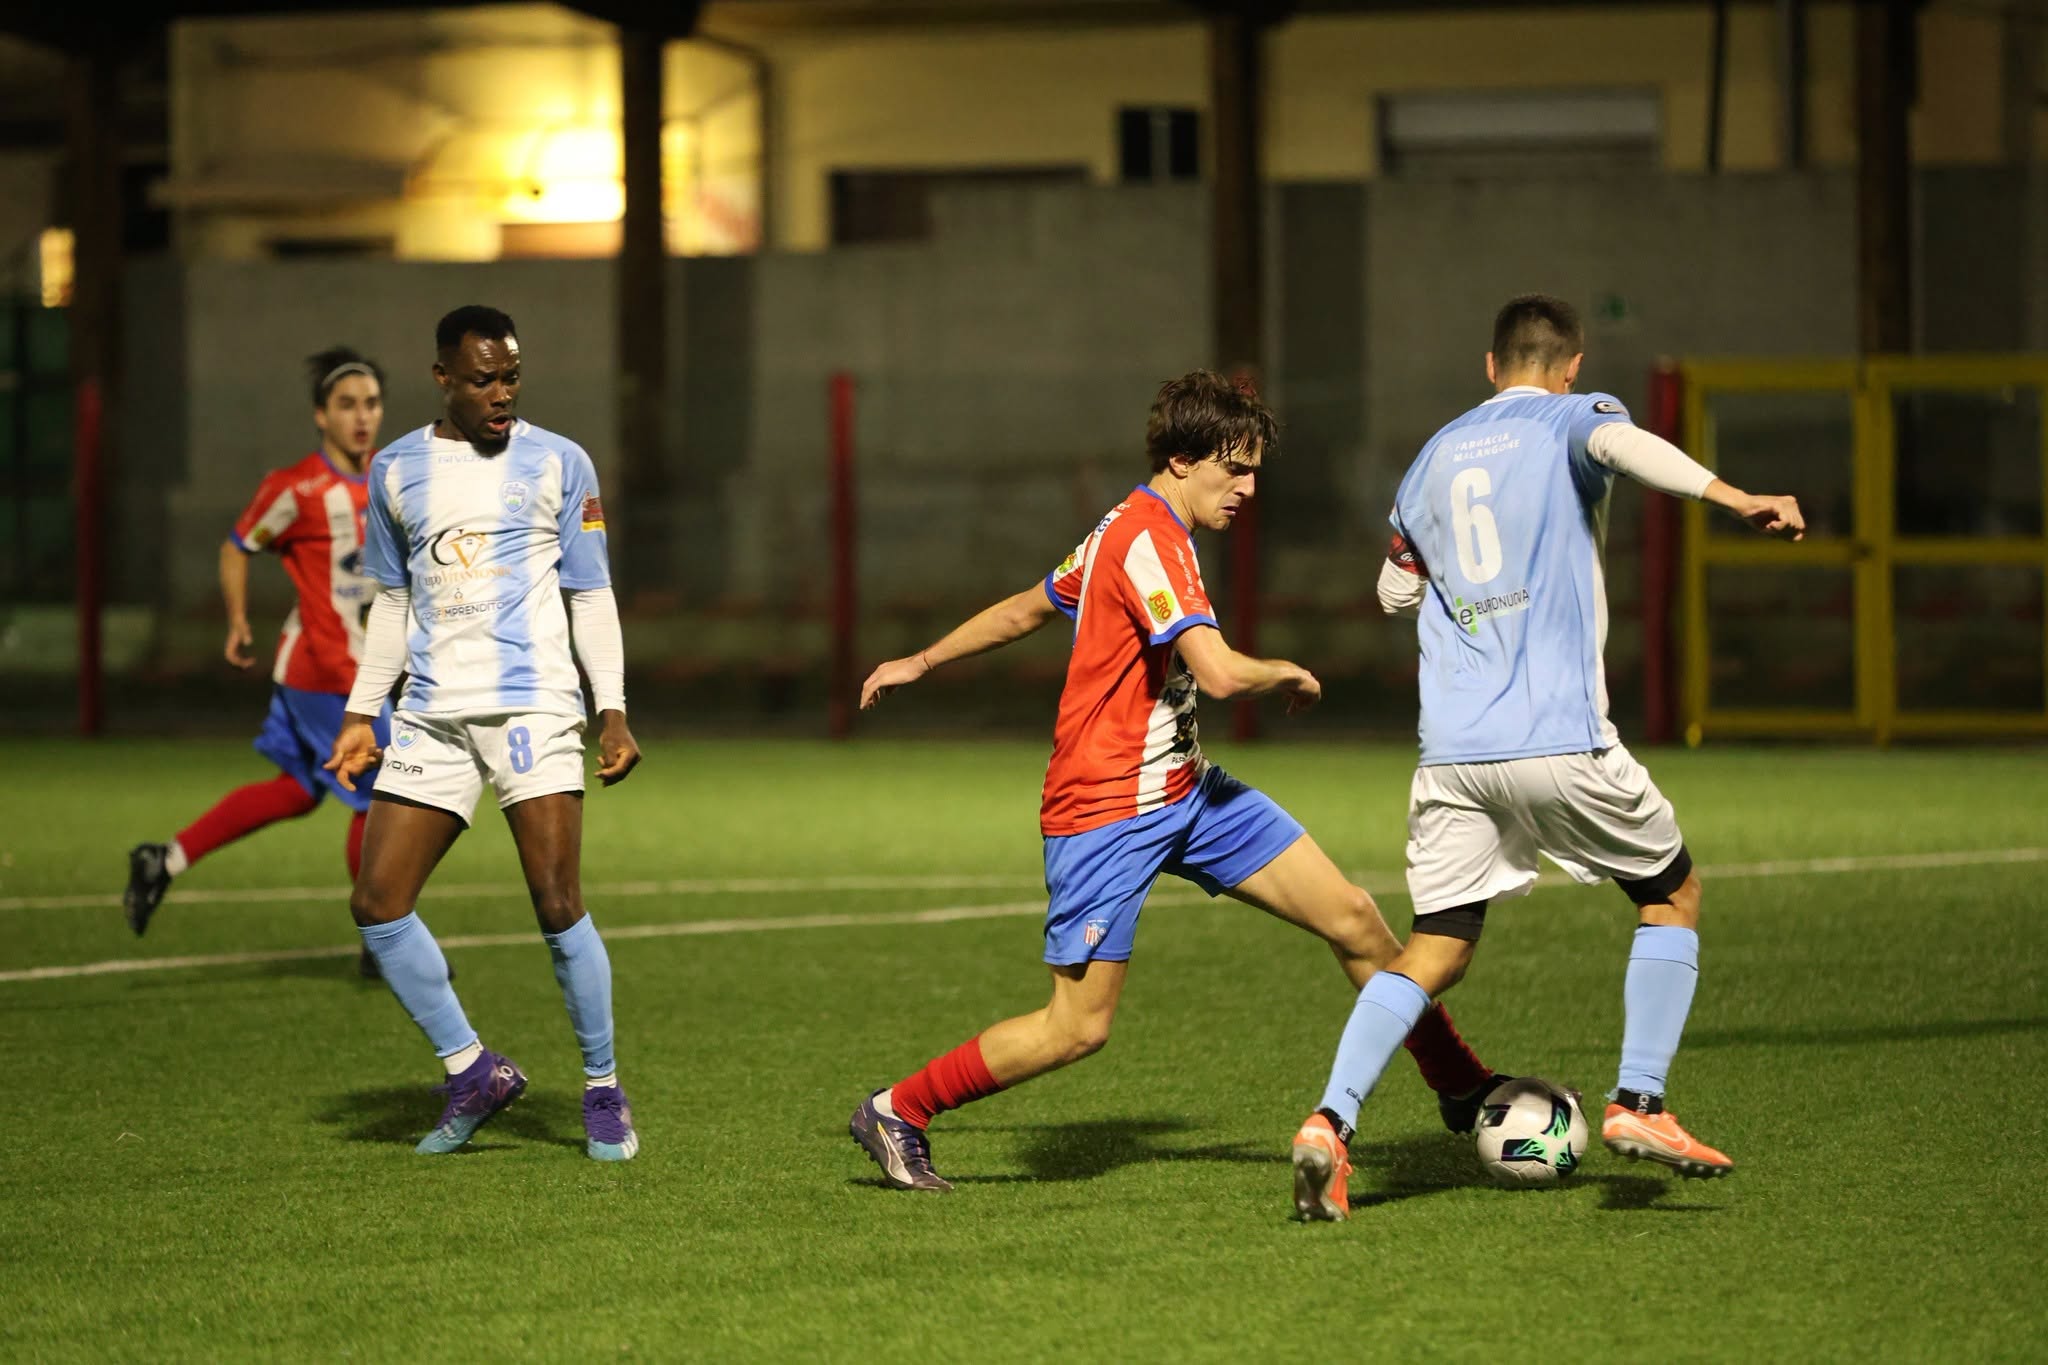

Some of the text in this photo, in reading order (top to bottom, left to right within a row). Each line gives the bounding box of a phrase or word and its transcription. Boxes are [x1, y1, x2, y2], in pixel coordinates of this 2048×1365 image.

[1450, 466, 1503, 585] 6
[1149, 591, 1172, 620] JERO
[507, 726, 534, 774] 8
